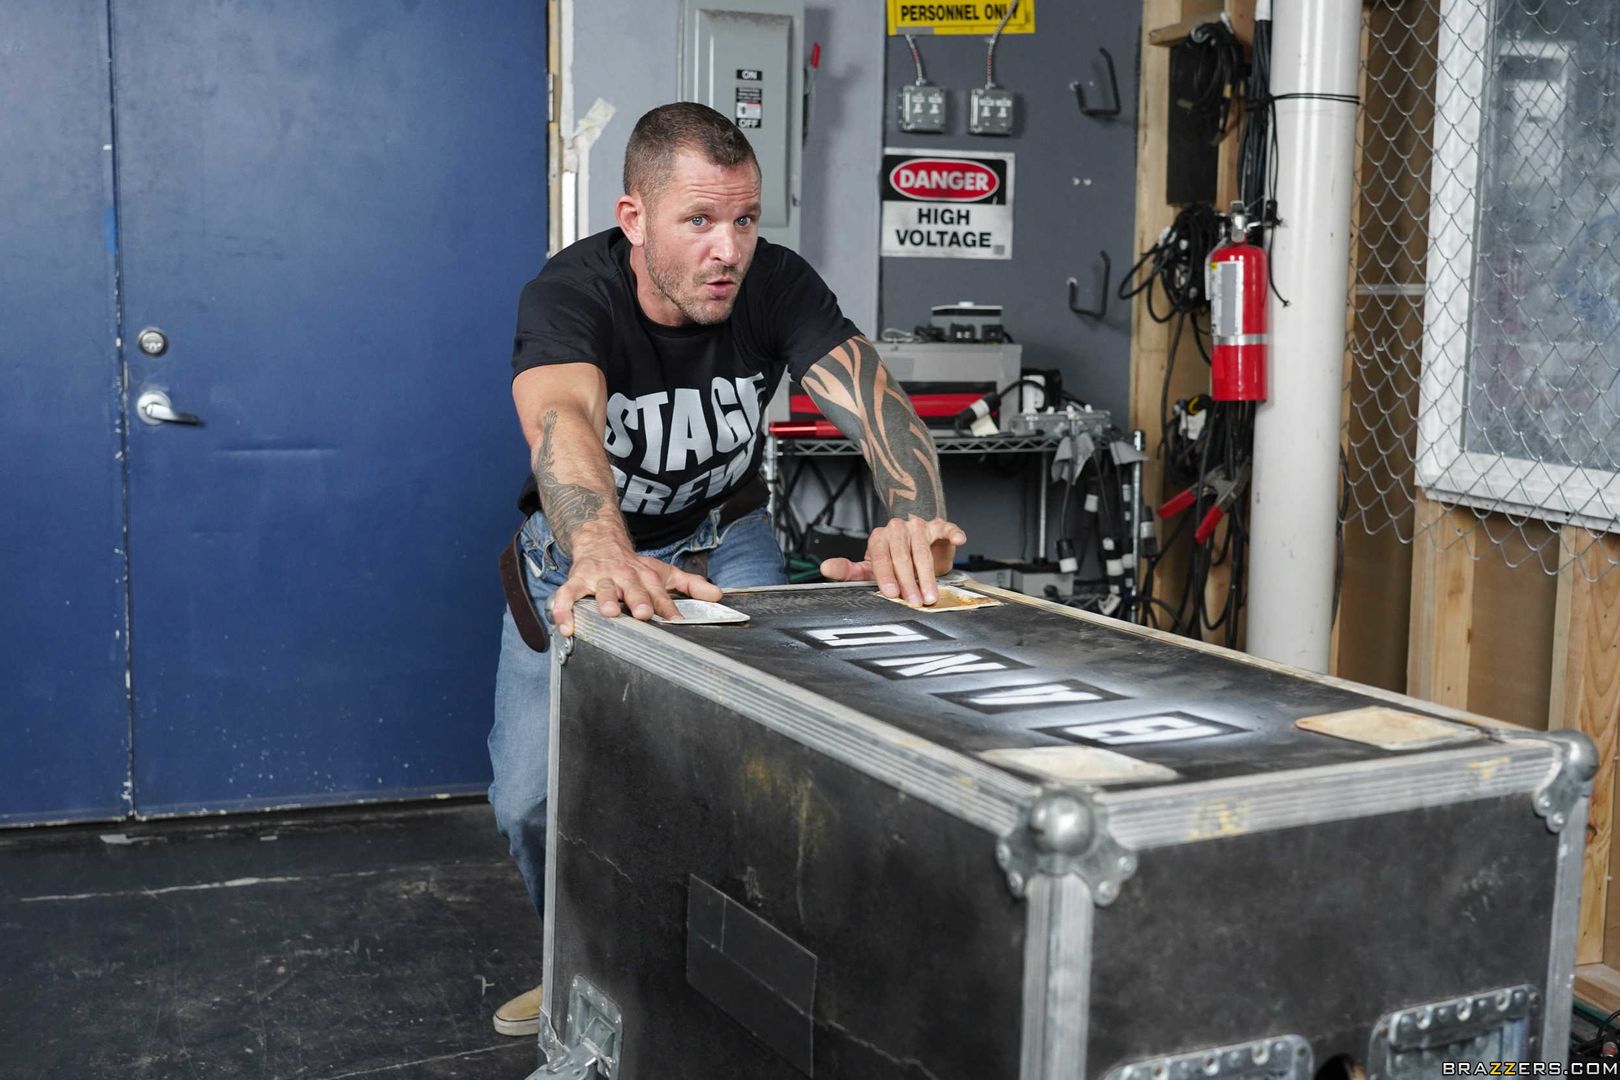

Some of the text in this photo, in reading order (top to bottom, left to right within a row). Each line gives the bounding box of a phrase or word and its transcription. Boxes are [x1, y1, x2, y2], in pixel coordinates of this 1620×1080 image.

[901, 4, 980, 21] PERSONNEL
[741, 70, 757, 80] ON
[738, 119, 758, 128] OFF
[899, 170, 989, 191] DANGER
[918, 208, 970, 225] HIGH
[896, 229, 992, 248] VOLTAGE
